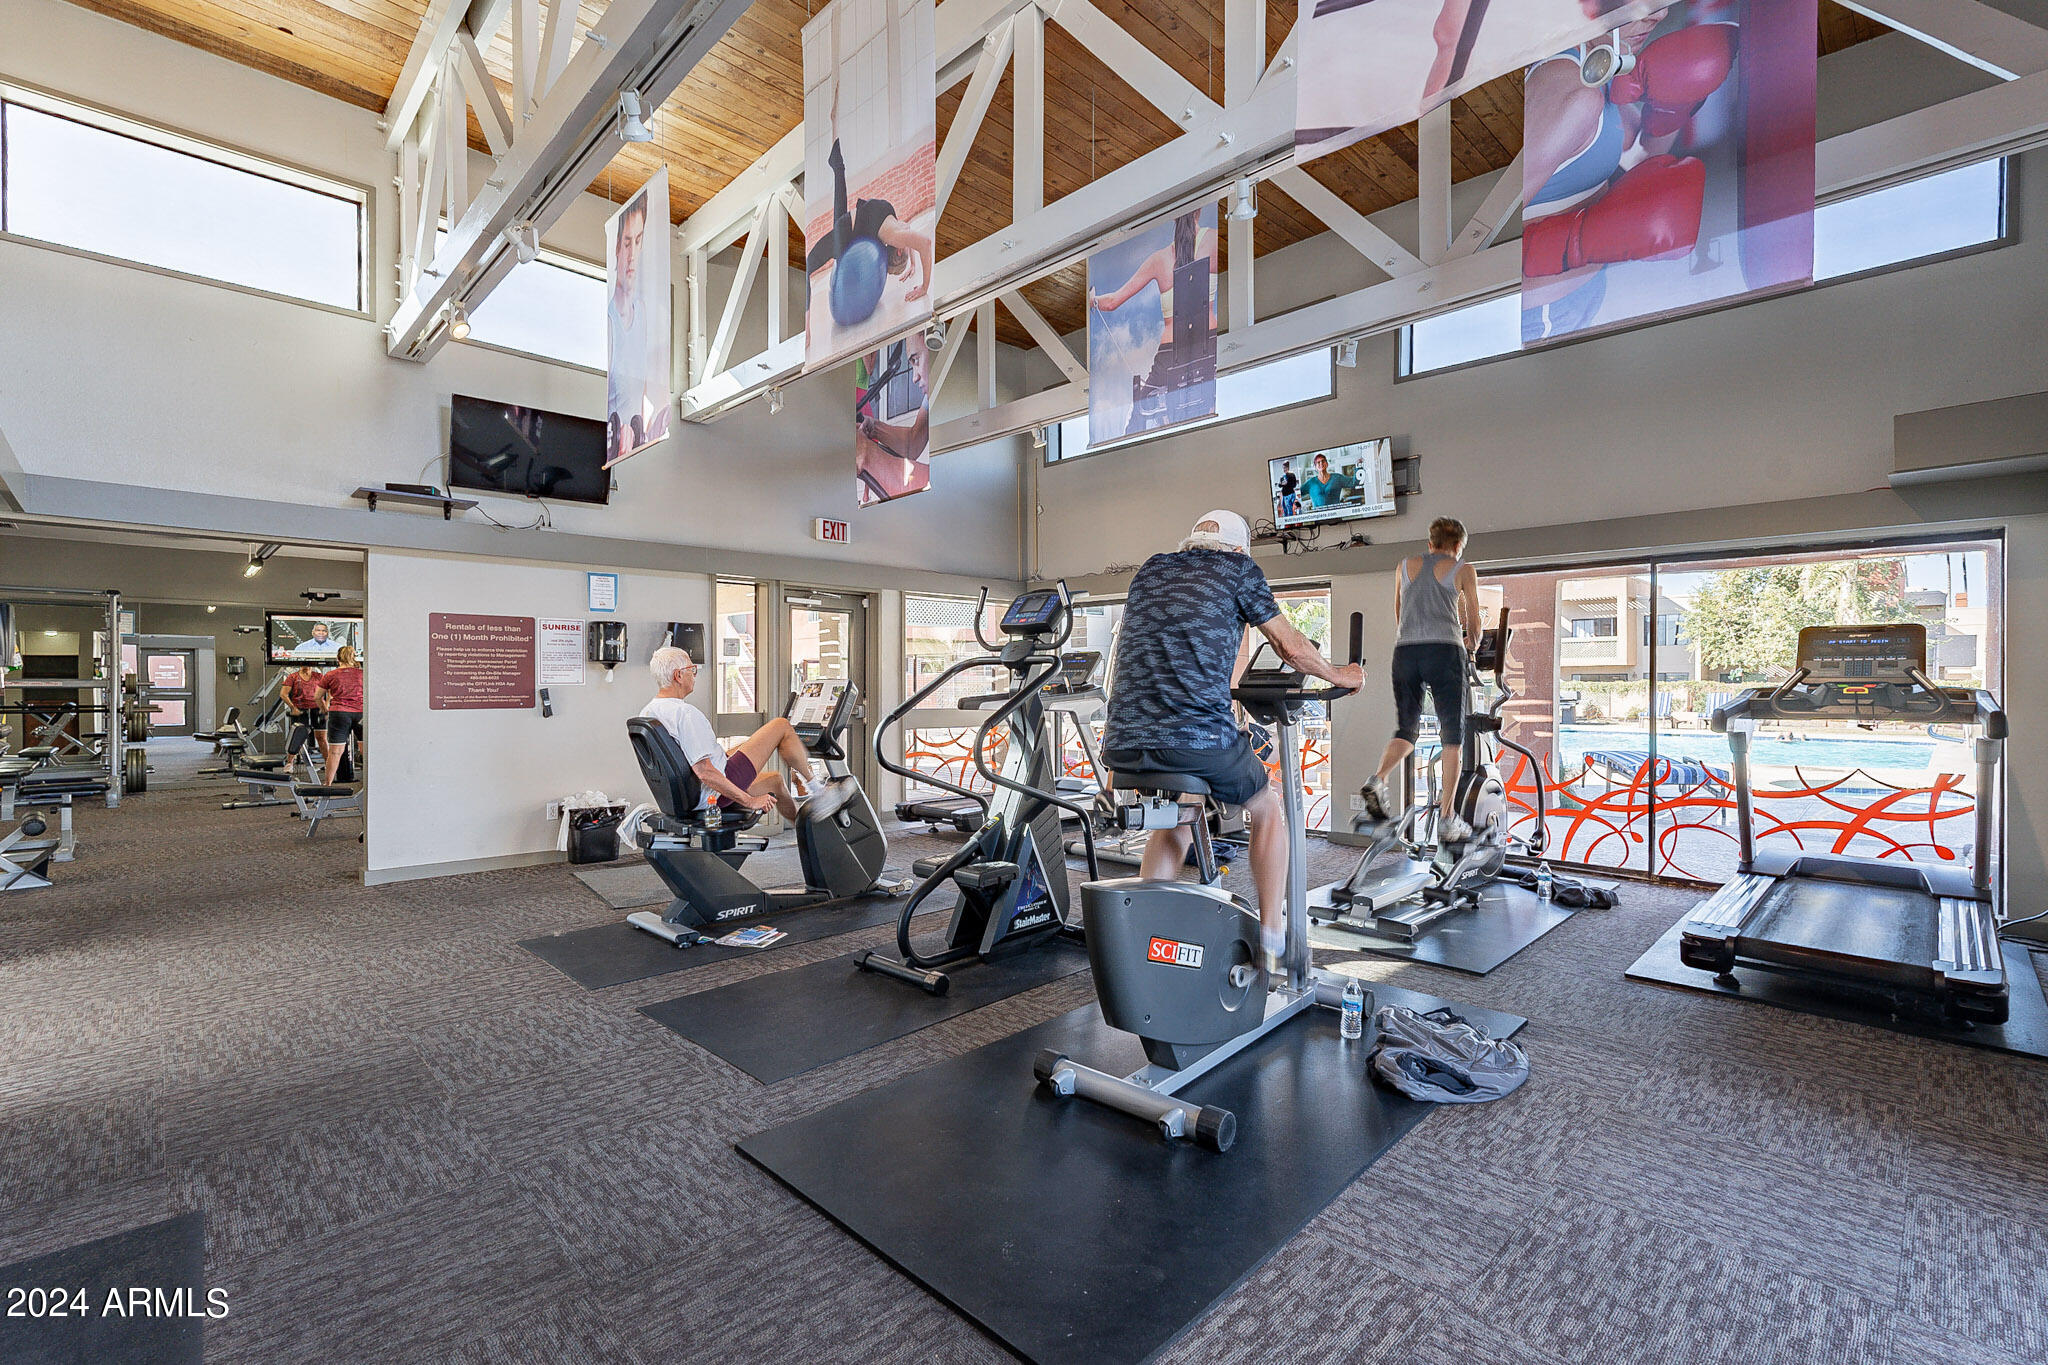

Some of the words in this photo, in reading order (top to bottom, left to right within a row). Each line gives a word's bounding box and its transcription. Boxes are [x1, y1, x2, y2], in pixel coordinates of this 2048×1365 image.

[823, 520, 847, 542] EXIT
[446, 622, 476, 630] Rentals
[1461, 868, 1479, 880] SPIRIT
[716, 904, 757, 920] SPIRIT
[1014, 912, 1050, 930] StairMaster
[1151, 942, 1200, 962] SCIFIT
